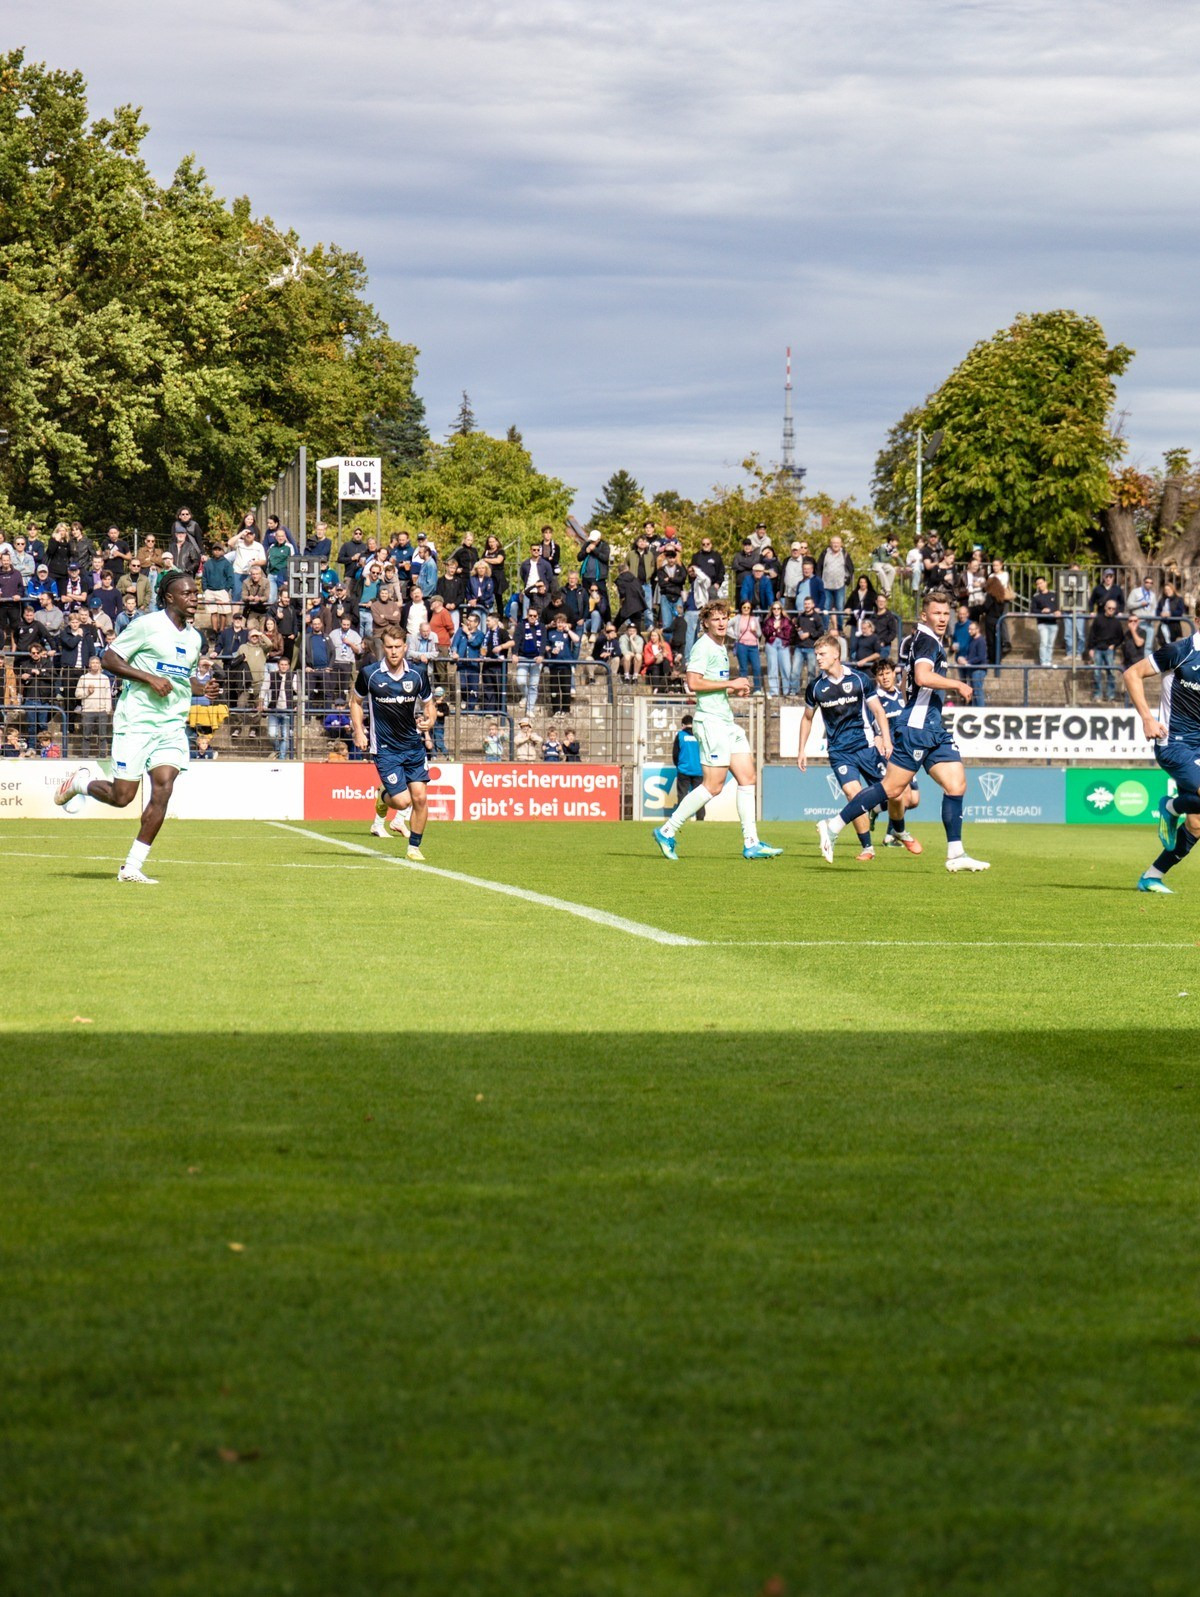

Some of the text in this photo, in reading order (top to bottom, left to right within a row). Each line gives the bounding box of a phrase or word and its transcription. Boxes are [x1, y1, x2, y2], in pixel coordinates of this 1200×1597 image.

[349, 472, 371, 495] N
[995, 744, 1094, 753] Gemeinsam
[469, 769, 618, 793] Versicherungen
[0, 782, 22, 791] ser
[0, 796, 23, 806] ark
[469, 797, 607, 821] gibt's bei uns.
[996, 806, 1042, 816] SZABADI
